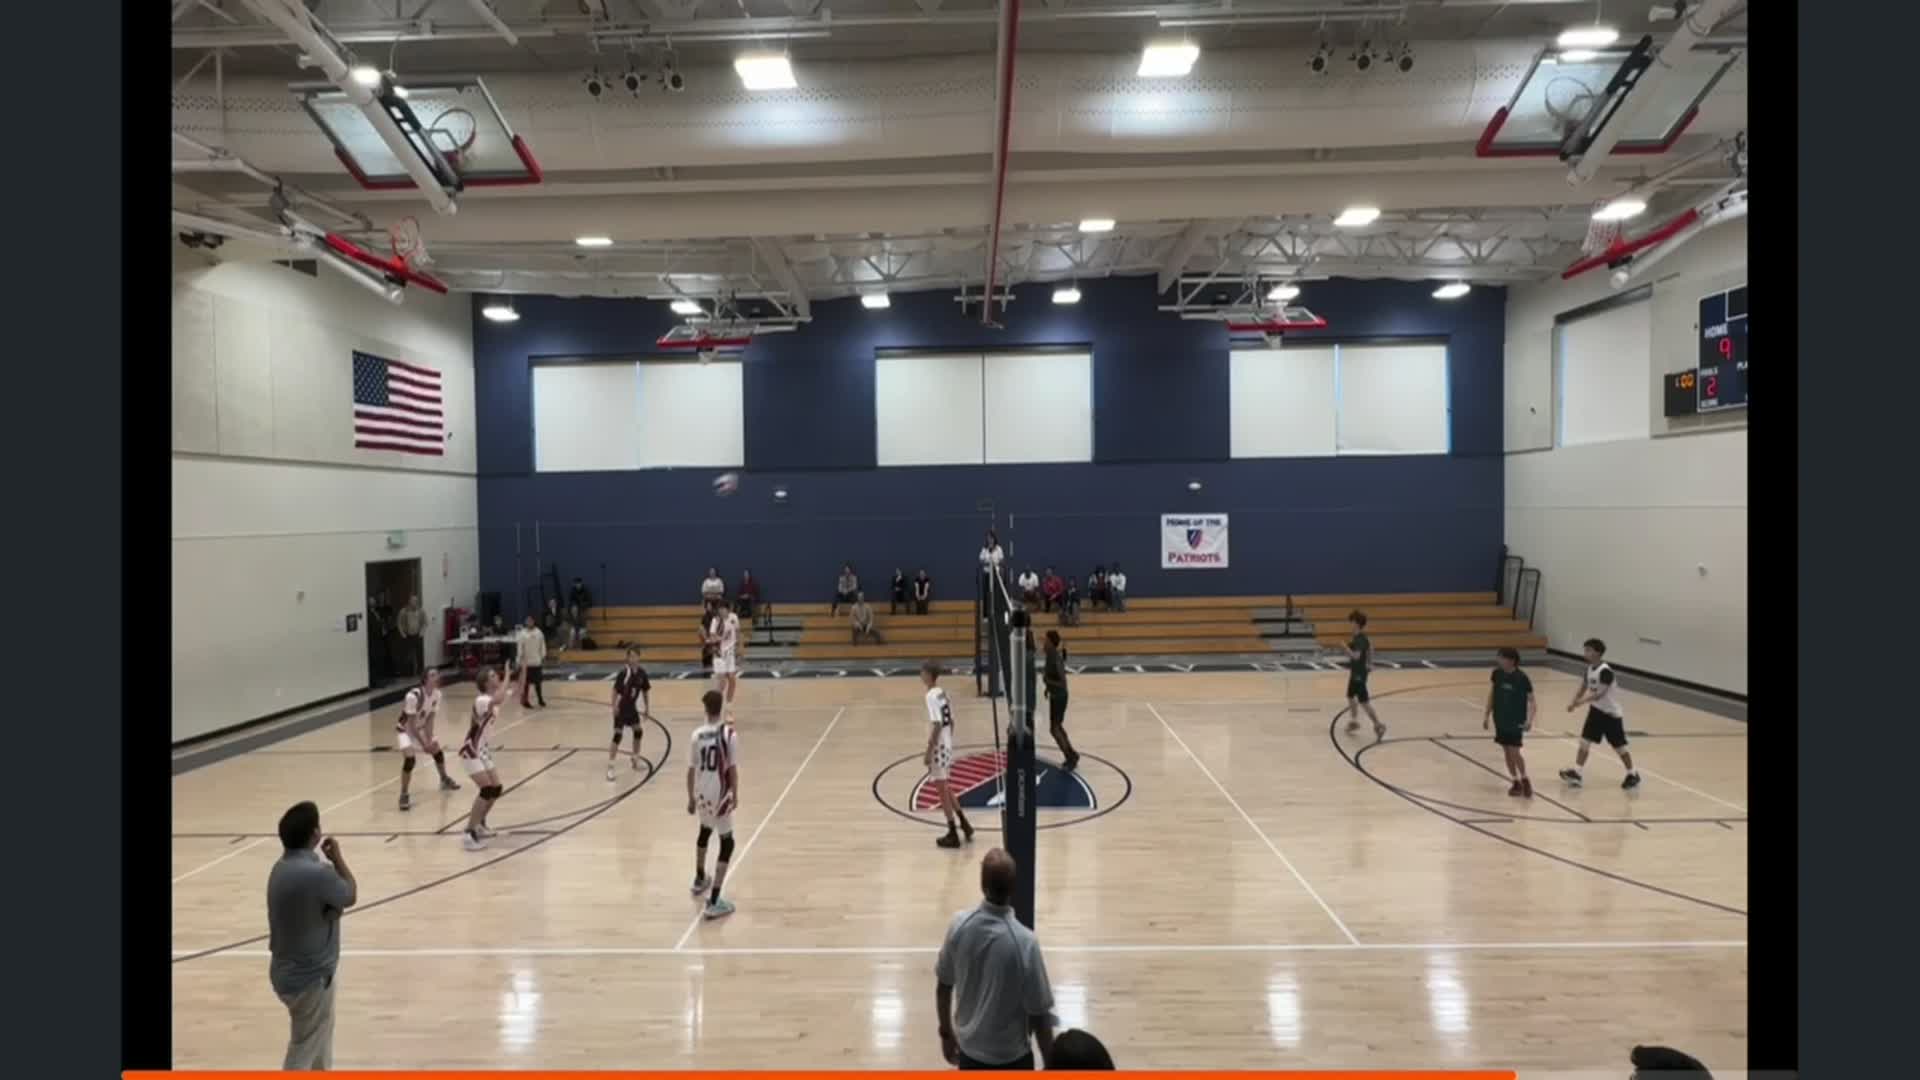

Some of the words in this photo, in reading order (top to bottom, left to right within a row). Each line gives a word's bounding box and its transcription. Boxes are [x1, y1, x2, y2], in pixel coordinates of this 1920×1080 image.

[1719, 338, 1731, 360] 9
[1706, 377, 1717, 396] 2
[1166, 518, 1190, 526] HOME
[1168, 552, 1221, 563] PATRIOTS
[700, 745, 718, 772] 10
